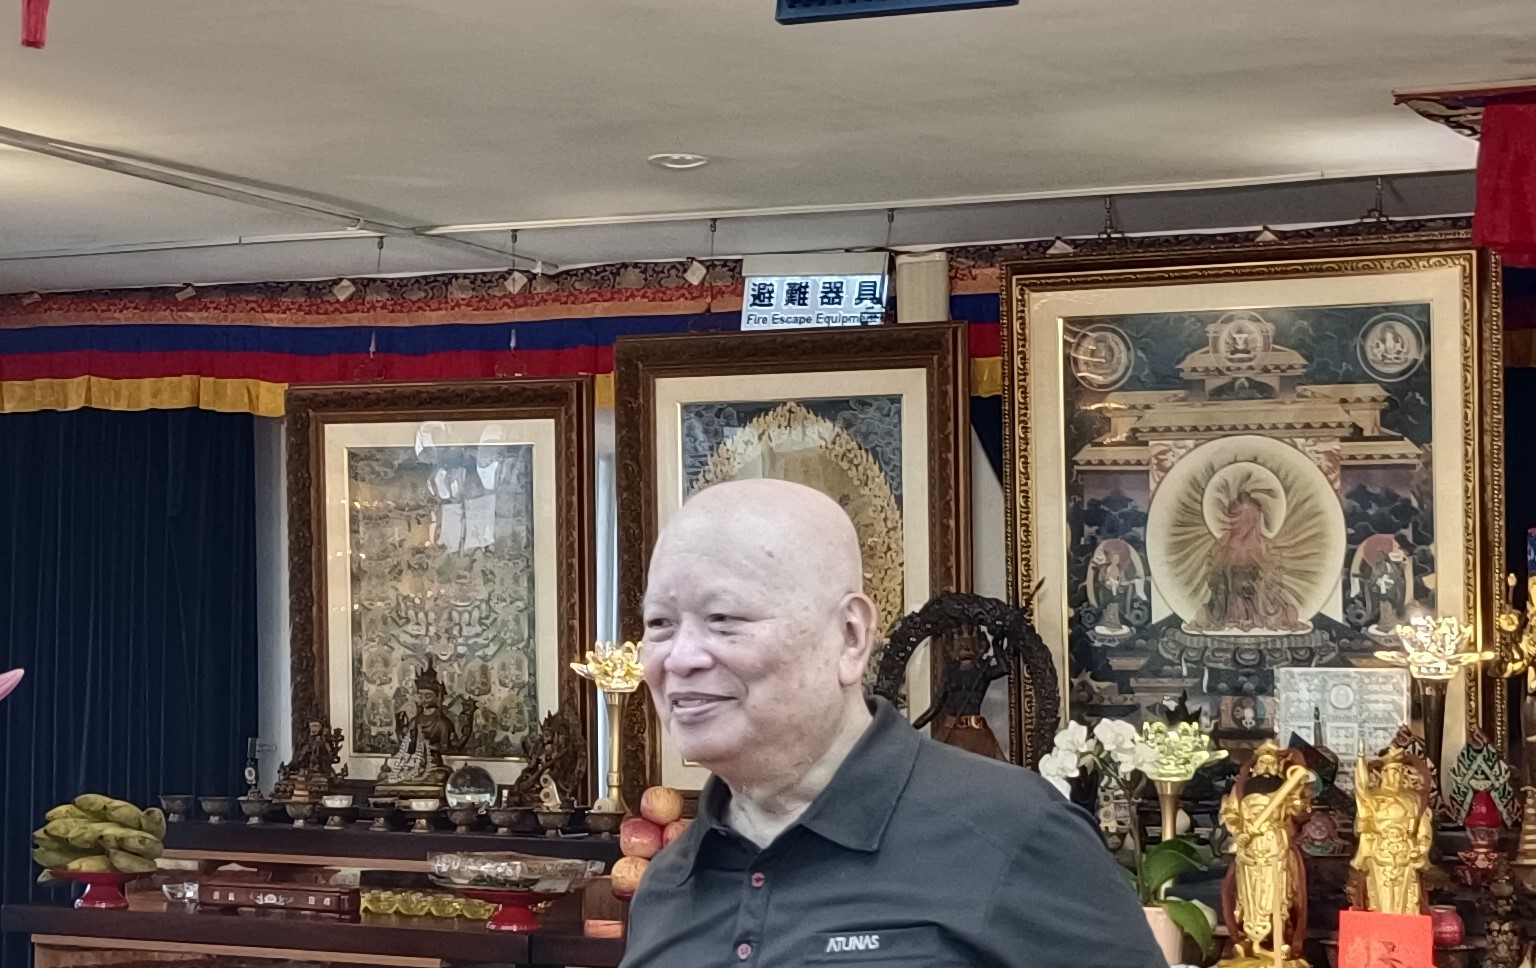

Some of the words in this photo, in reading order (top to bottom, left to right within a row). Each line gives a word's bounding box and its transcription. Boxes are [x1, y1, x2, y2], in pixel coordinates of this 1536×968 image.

[750, 281, 882, 307] 避難器具
[747, 313, 767, 325] Fire
[771, 312, 812, 325] Escape
[826, 934, 880, 952] ATUNAS
